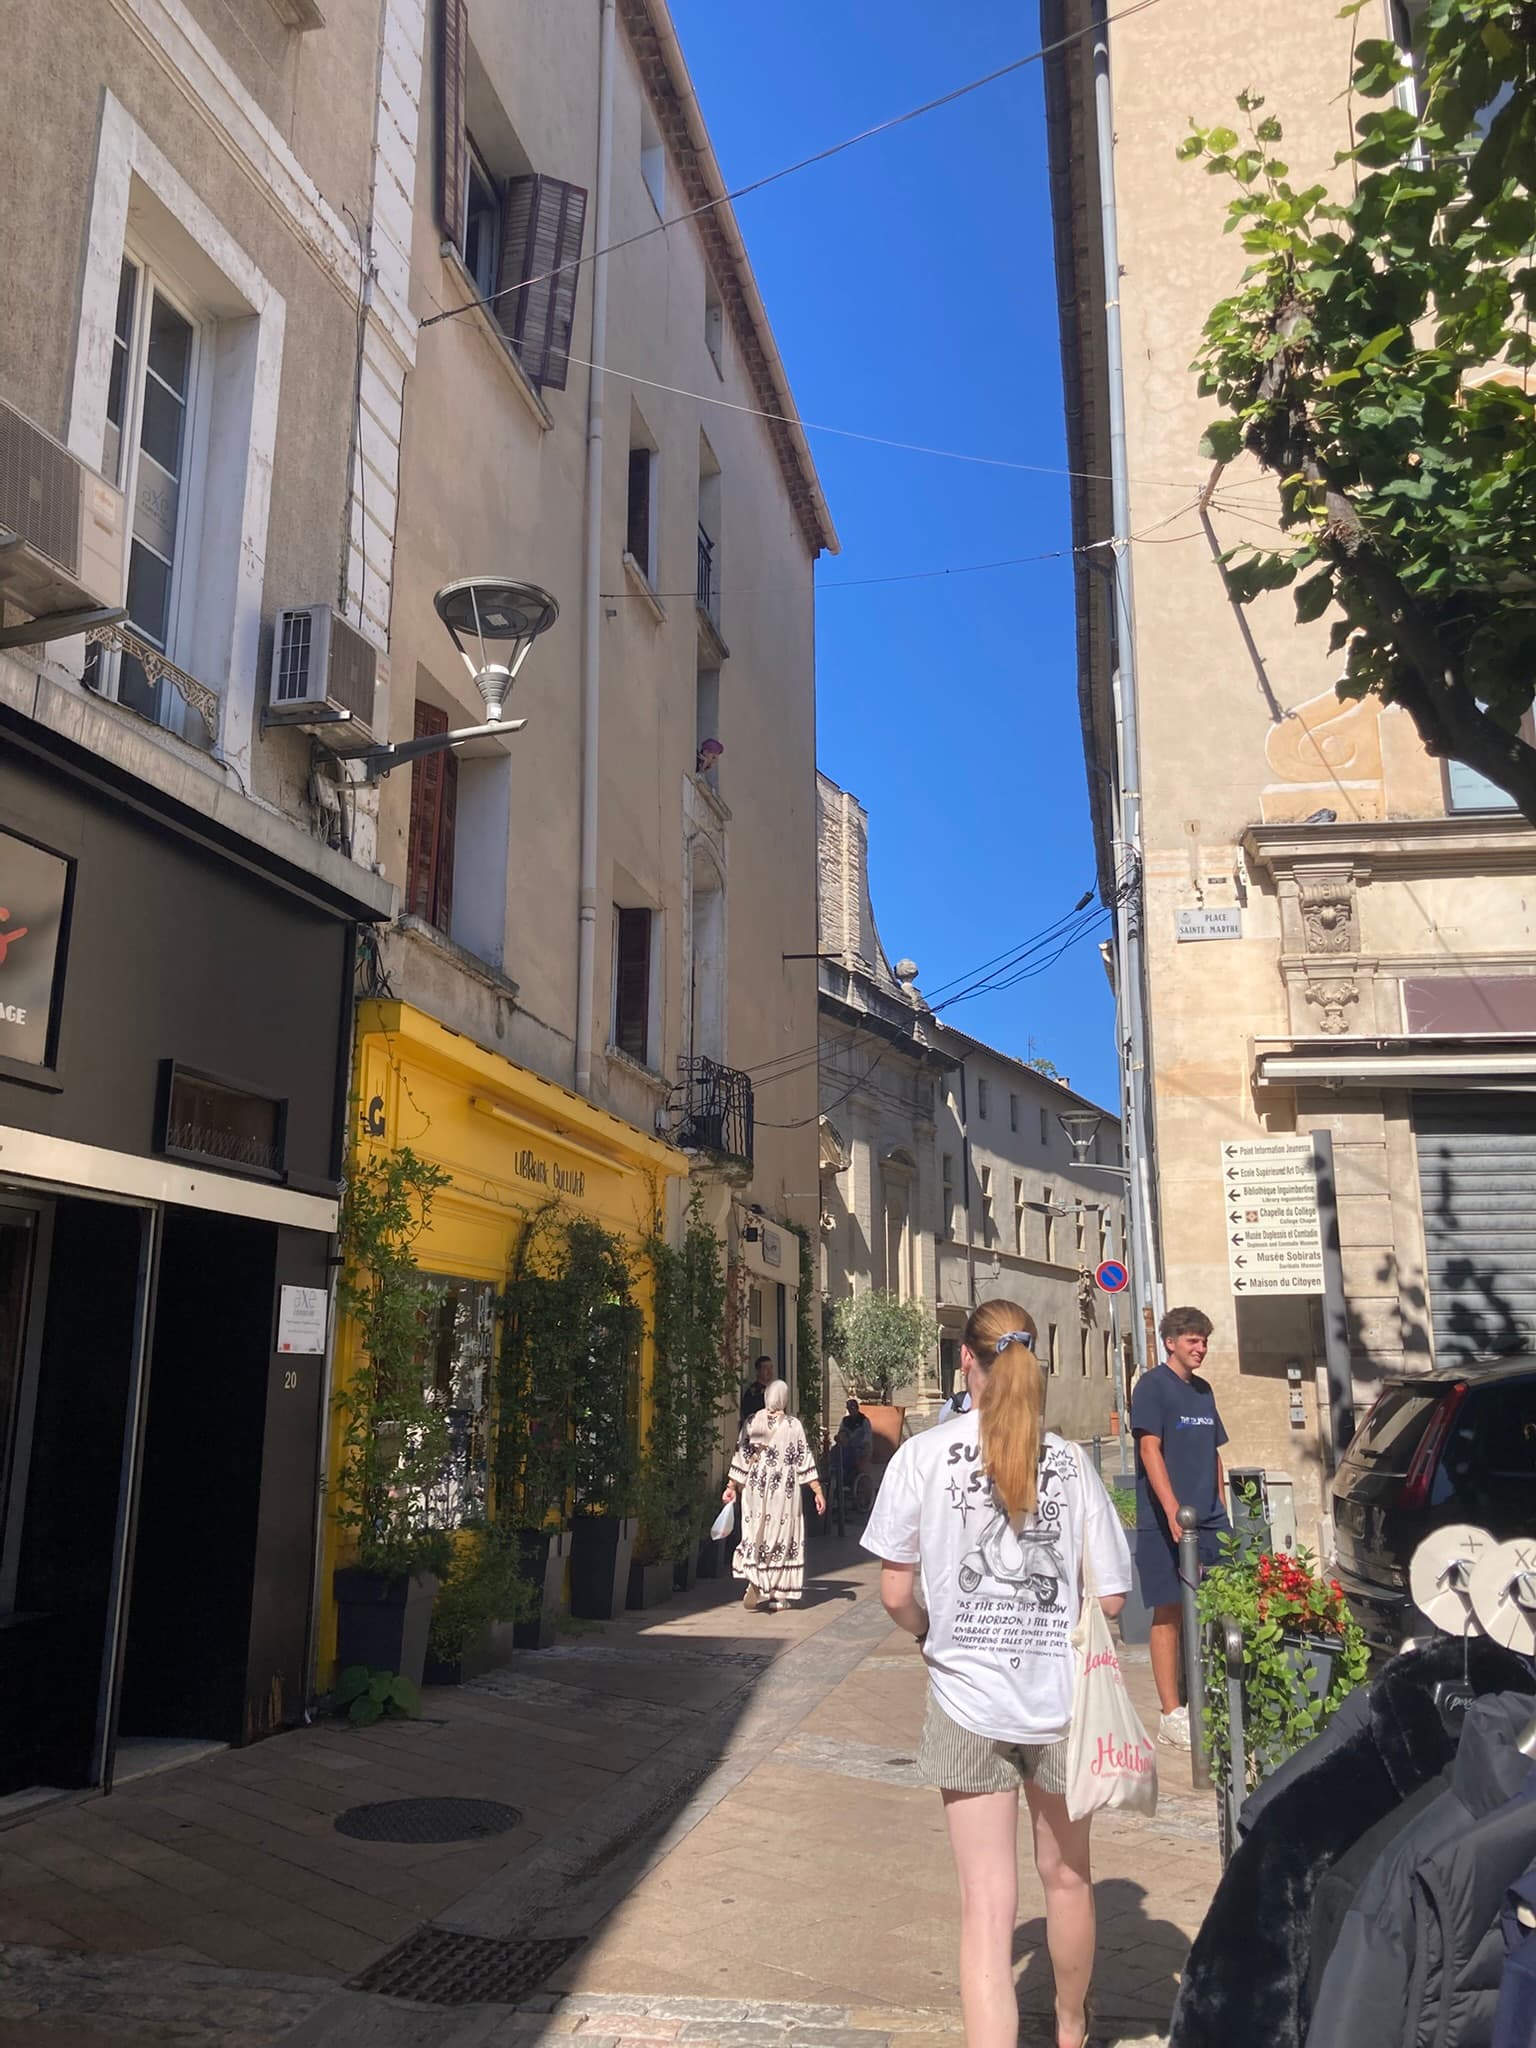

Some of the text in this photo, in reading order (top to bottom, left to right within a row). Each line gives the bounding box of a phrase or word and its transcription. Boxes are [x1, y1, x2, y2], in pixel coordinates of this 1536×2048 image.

[1205, 914, 1227, 922] PLACE
[1180, 925, 1239, 934] SAINTE MARTHE
[1240, 1143, 1311, 1155] Point Information Jeunesse
[1260, 1207, 1285, 1218] Chapelle
[1286, 1207, 1294, 1217] du
[1256, 1250, 1321, 1262] Musée Sobirats
[1249, 1276, 1322, 1289] Maison du Citoyen
[284, 1371, 297, 1389] 20
[975, 1601, 994, 1611] THE
[996, 1602, 1015, 1611] SUN
[954, 1614, 975, 1623] THE
[1033, 1617, 1048, 1627] FEEL
[1052, 1619, 1069, 1629] THE
[954, 1626, 991, 1635] EMBRACE
[1003, 1628, 1019, 1637] THE
[951, 1634, 999, 1644] WHISPERING
[1001, 1637, 1023, 1645] TALES
